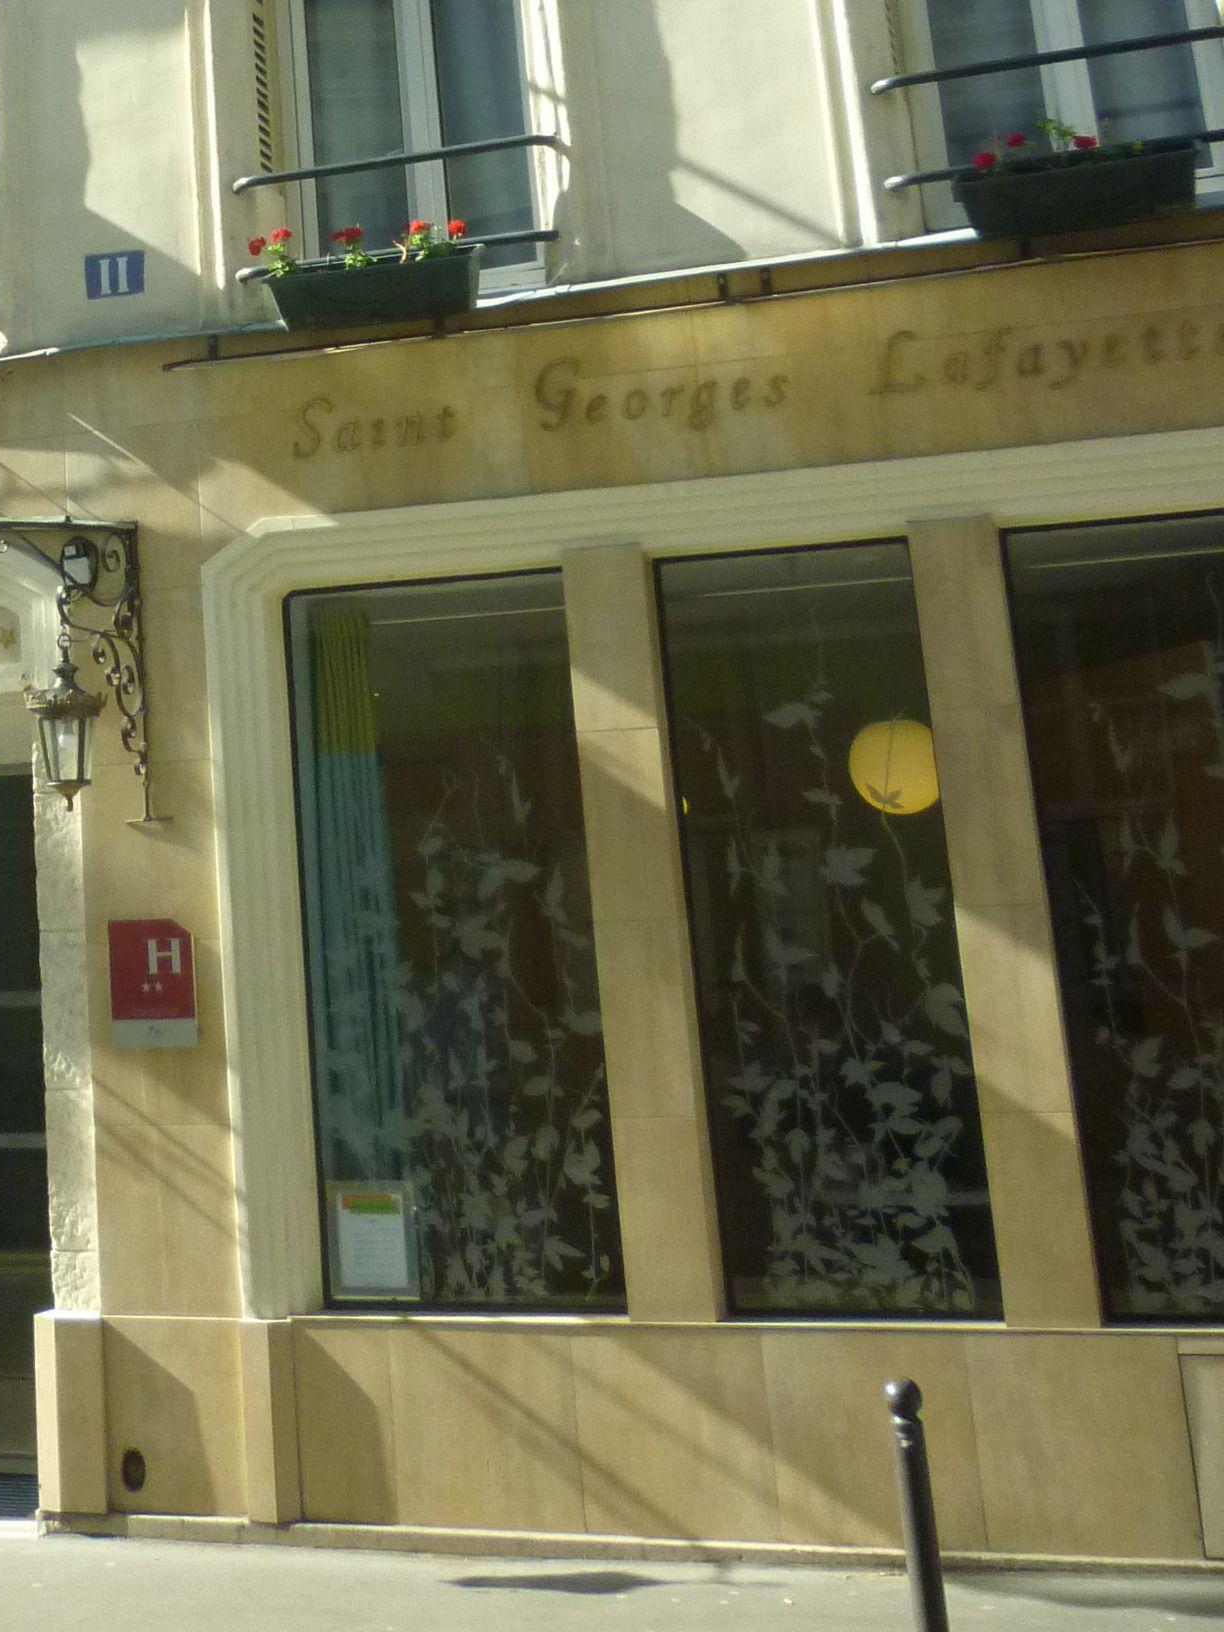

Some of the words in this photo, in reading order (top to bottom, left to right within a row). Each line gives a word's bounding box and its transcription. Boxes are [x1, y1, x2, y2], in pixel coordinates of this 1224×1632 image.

[98, 256, 130, 295] 11
[292, 397, 457, 462] Saint
[535, 358, 790, 432] Georges
[146, 937, 183, 975] H
